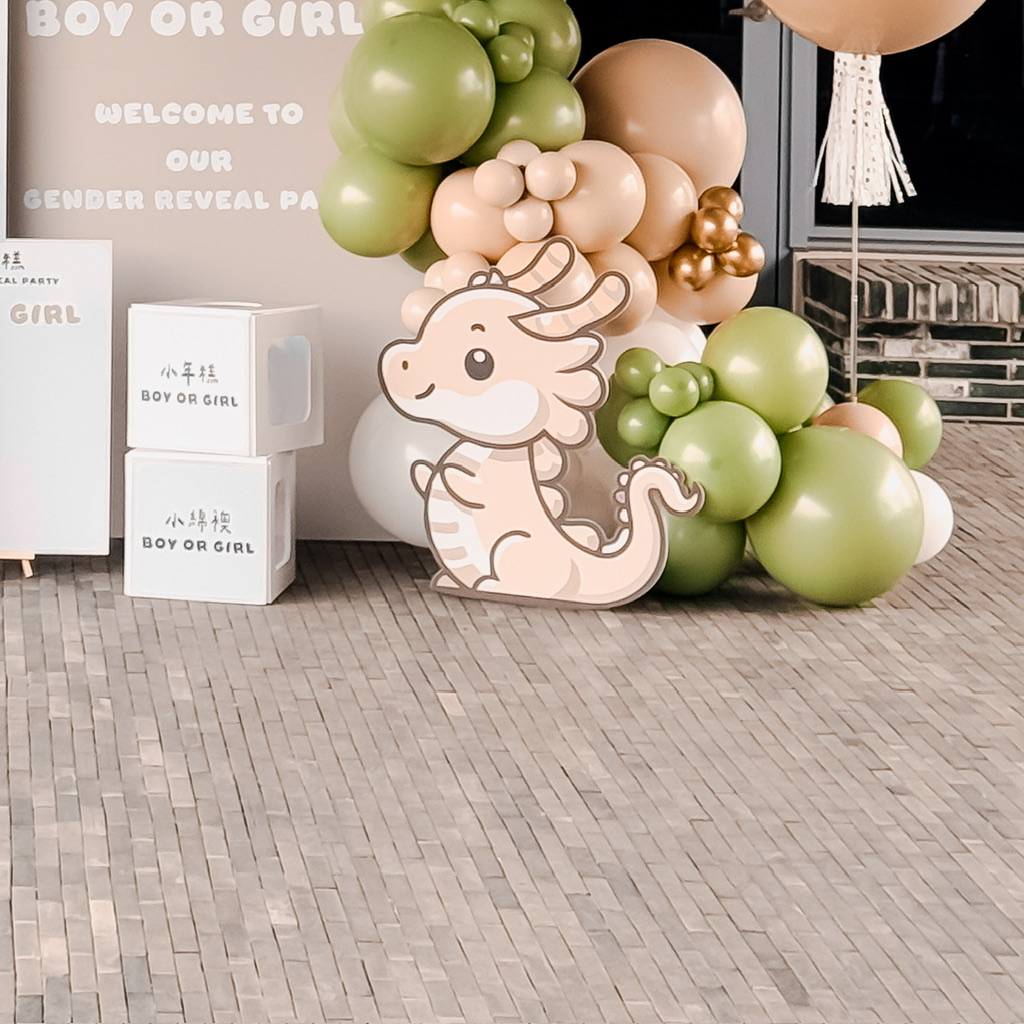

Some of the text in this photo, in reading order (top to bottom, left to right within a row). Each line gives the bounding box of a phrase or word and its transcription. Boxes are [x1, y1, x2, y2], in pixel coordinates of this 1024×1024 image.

[26, 0, 364, 37] BOY OR GIRL
[94, 103, 304, 125] WELCOME TO
[166, 149, 232, 172] OUR
[23, 190, 144, 210] GENDER
[155, 190, 269, 210] REVEAL
[22, 277, 60, 285] PARTY
[10, 303, 81, 324] GIRL
[160, 361, 219, 386] 小年糕
[141, 390, 238, 407] BOY OR GIRL
[142, 536, 255, 554] BOY OR GIRL
